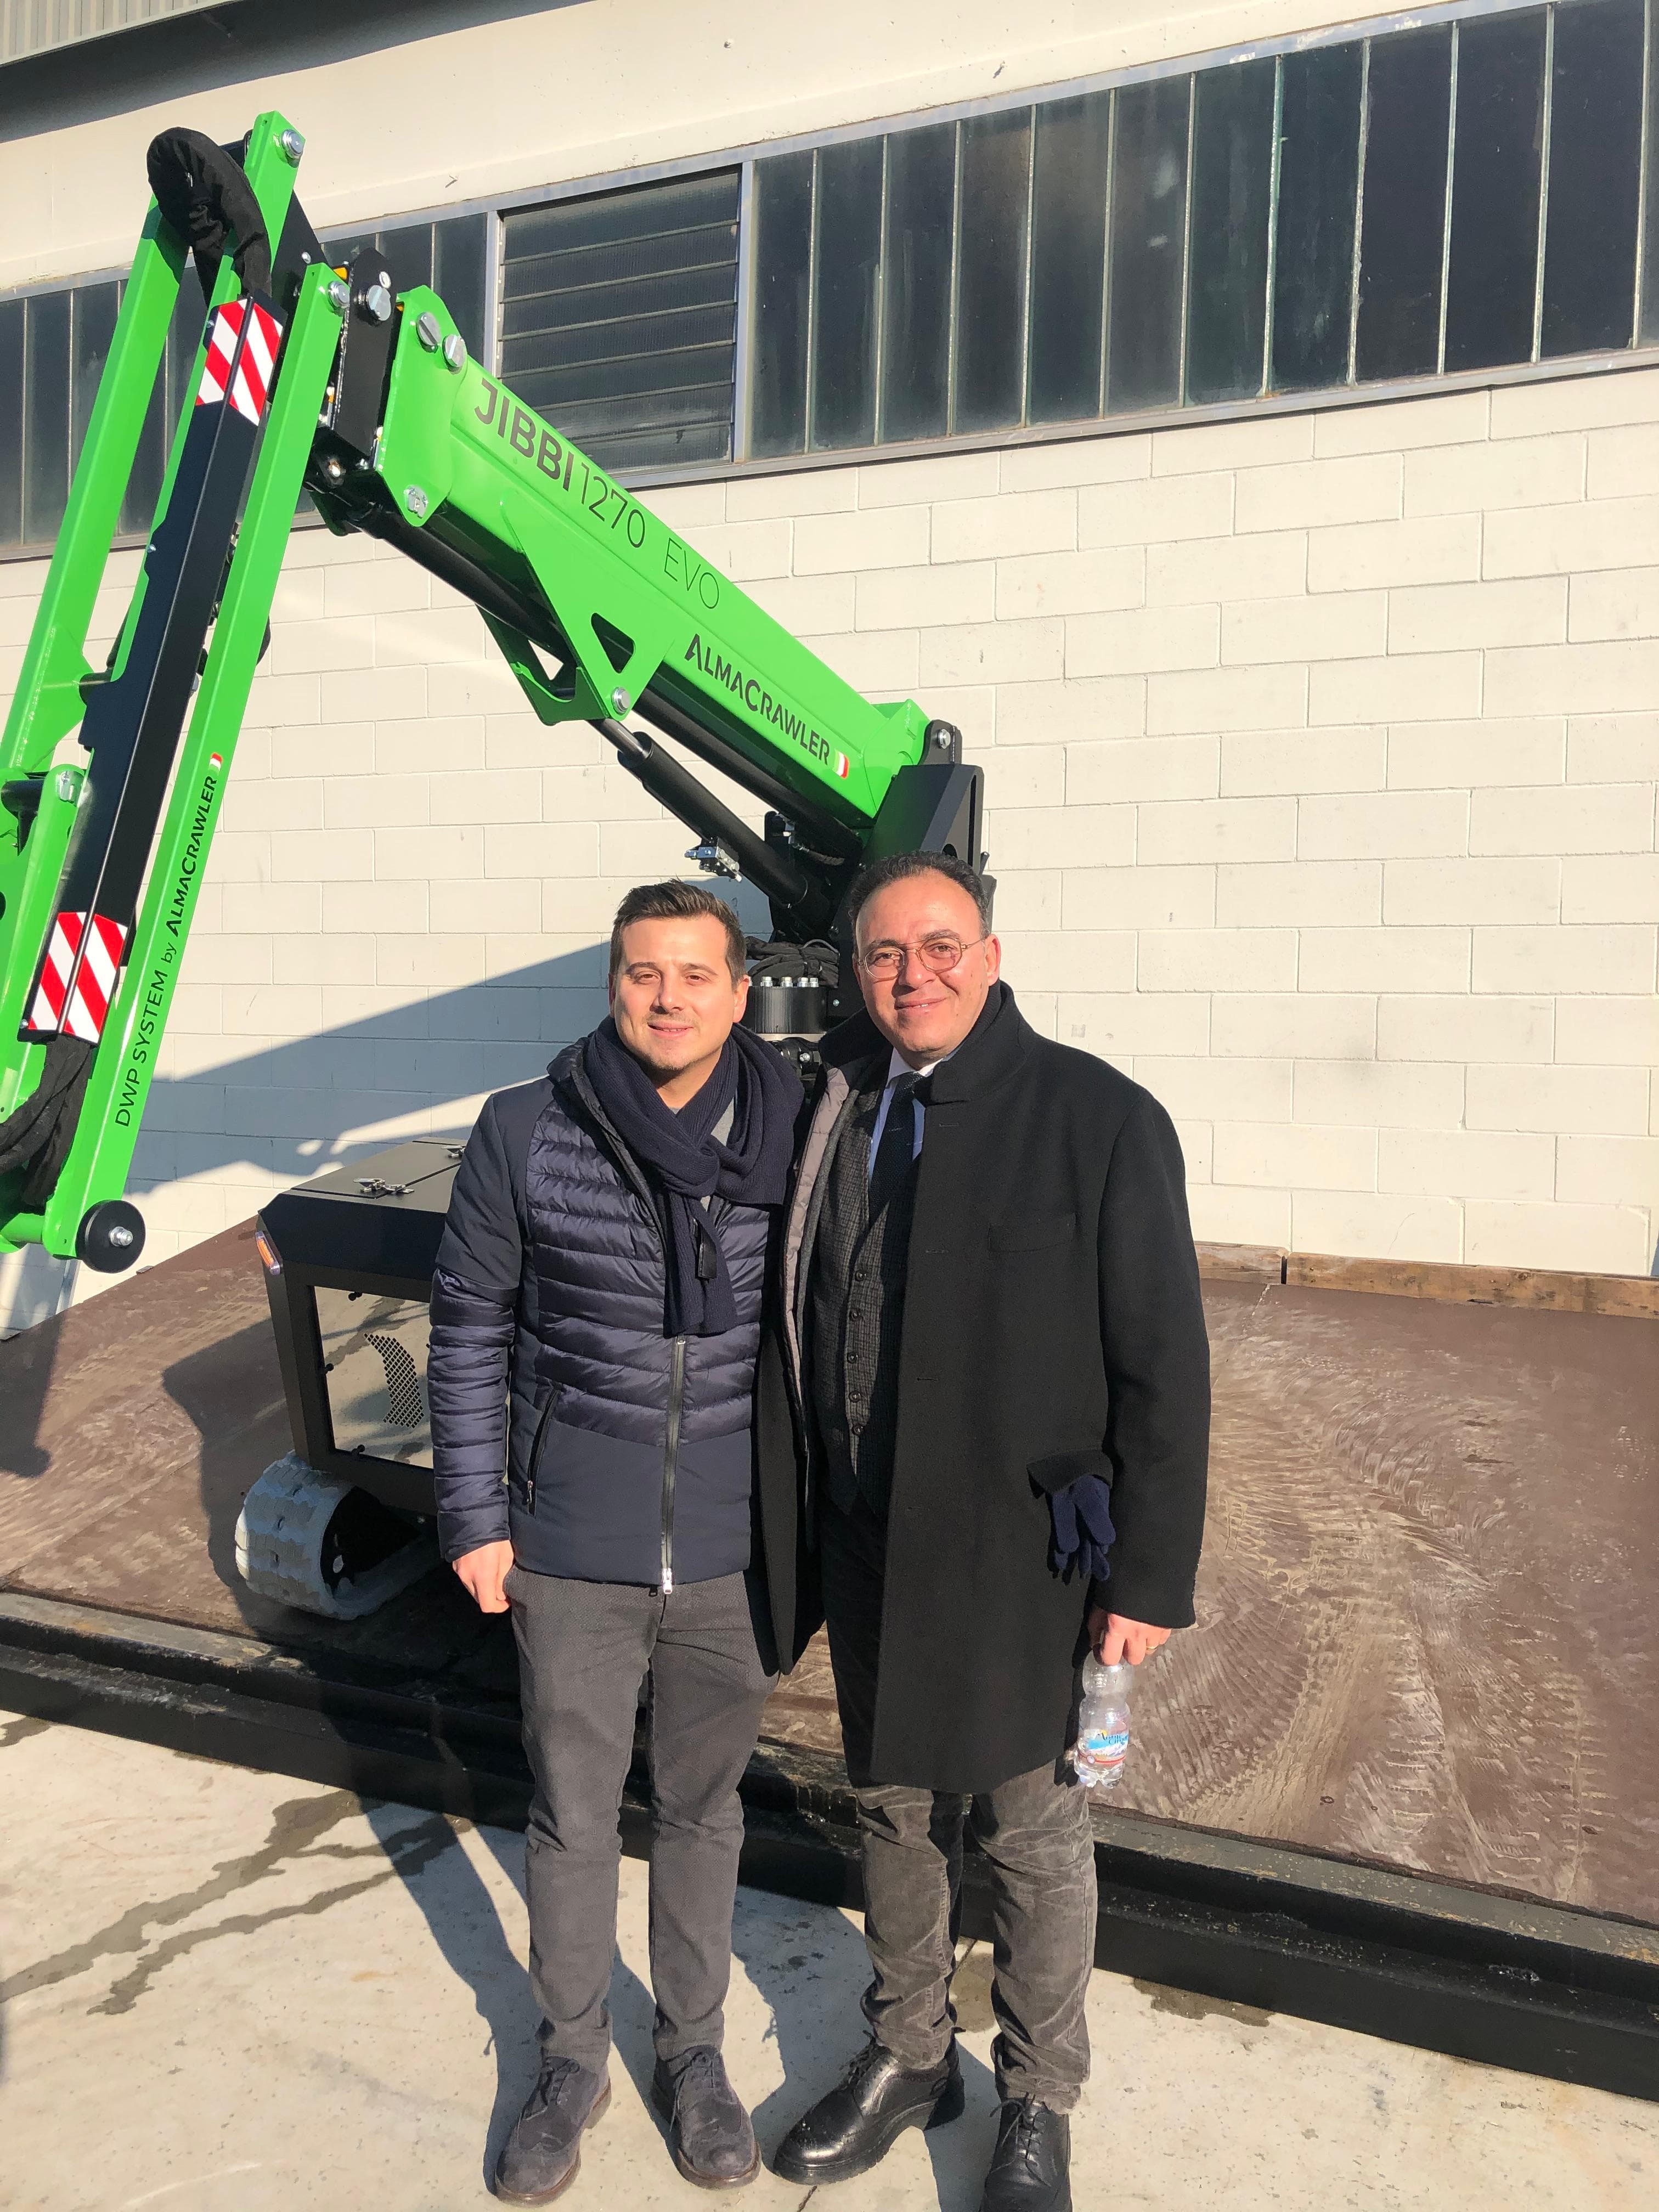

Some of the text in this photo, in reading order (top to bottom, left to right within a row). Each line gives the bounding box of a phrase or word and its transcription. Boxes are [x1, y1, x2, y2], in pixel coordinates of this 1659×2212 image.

[474, 378, 719, 610] JIBBI 1270 EVO
[684, 633, 831, 765] ALMACRAWLER
[115, 775, 217, 1127] DWP SYSTEM by ALMACRAWLER
